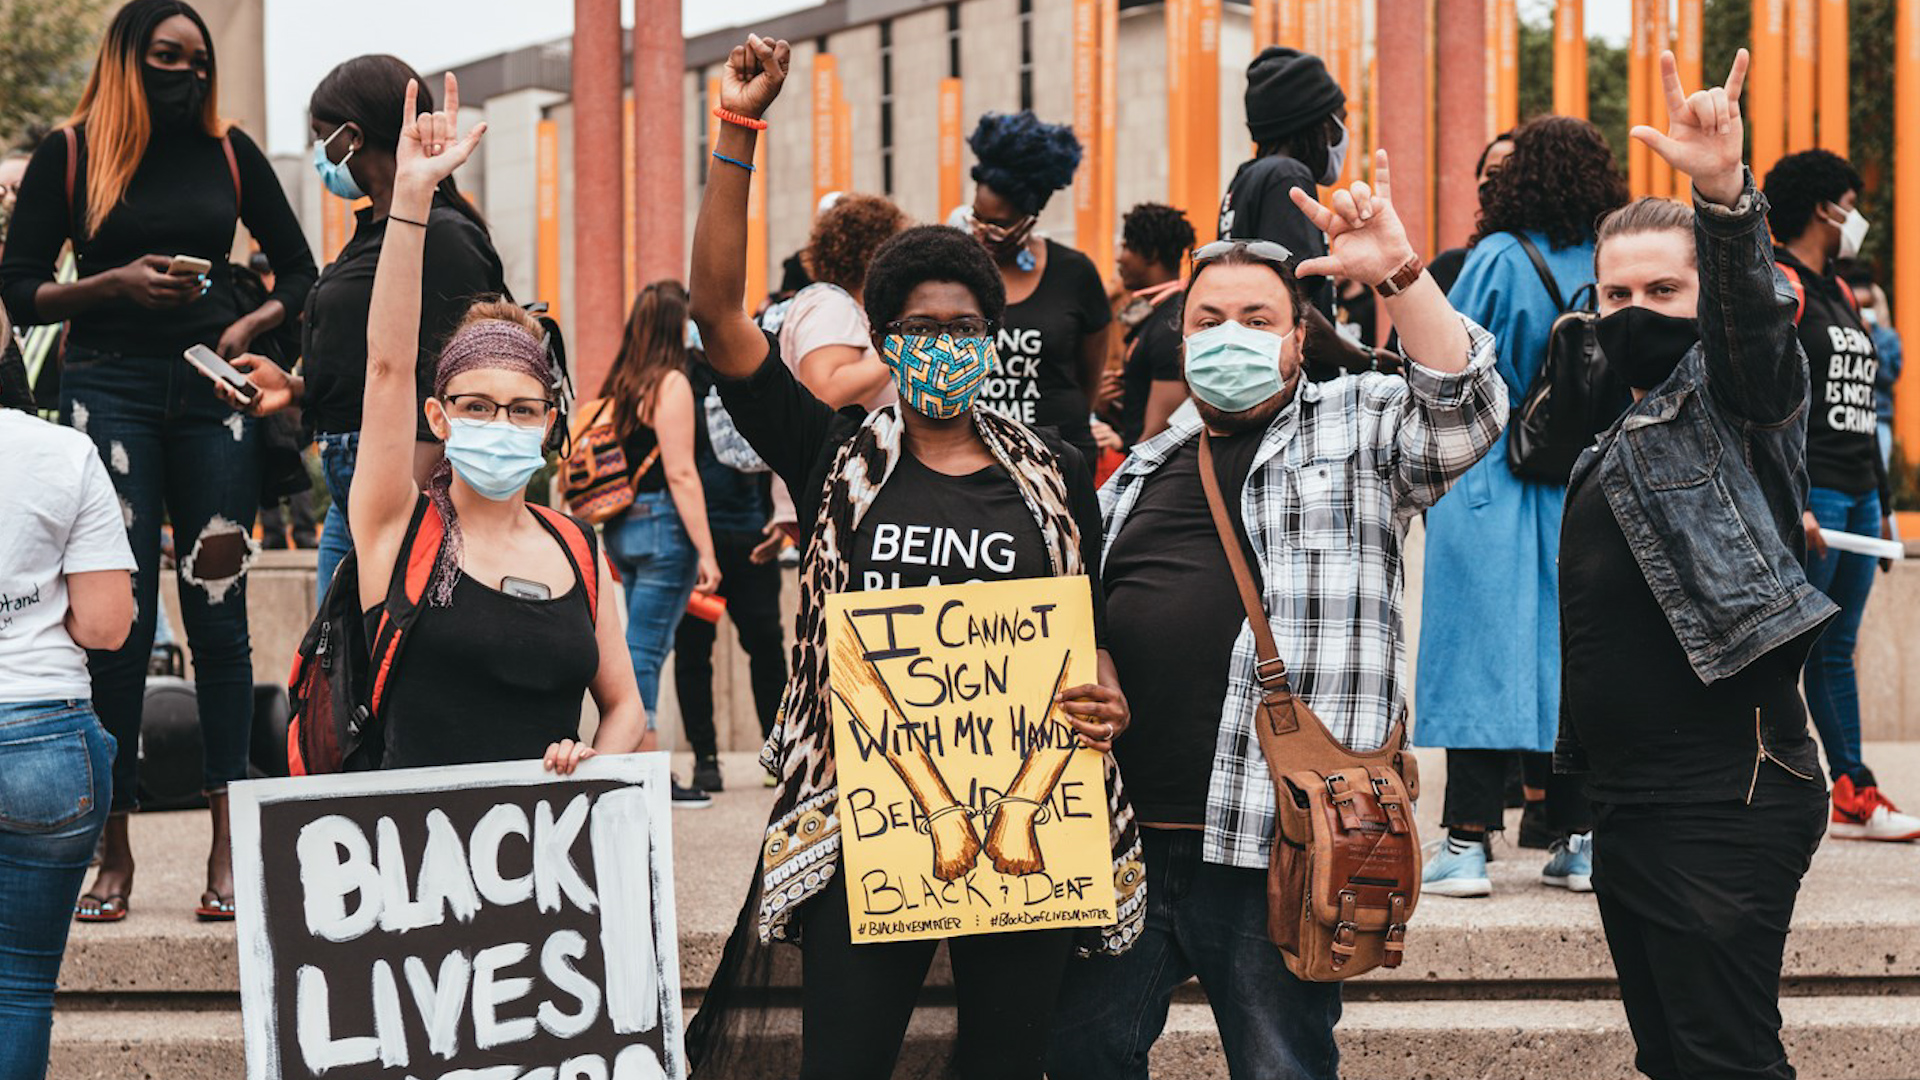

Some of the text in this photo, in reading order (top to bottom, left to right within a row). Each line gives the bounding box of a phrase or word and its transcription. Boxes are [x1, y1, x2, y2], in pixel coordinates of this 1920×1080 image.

[1827, 325, 1874, 355] BEIN
[1022, 380, 1041, 399] A
[1825, 381, 1842, 403] IS
[1842, 381, 1872, 407] NOT
[1828, 354, 1878, 384] BLAC
[870, 523, 1017, 574] BEING
[851, 599, 1057, 661] I CANNOT
[904, 655, 1009, 708] SIGN
[848, 709, 944, 762] WITH
[954, 711, 993, 756] MY
[297, 794, 600, 942] BLACK
[861, 869, 992, 915] BLACK
[1017, 871, 1093, 906] DEAF
[296, 930, 601, 1076] LIVES
